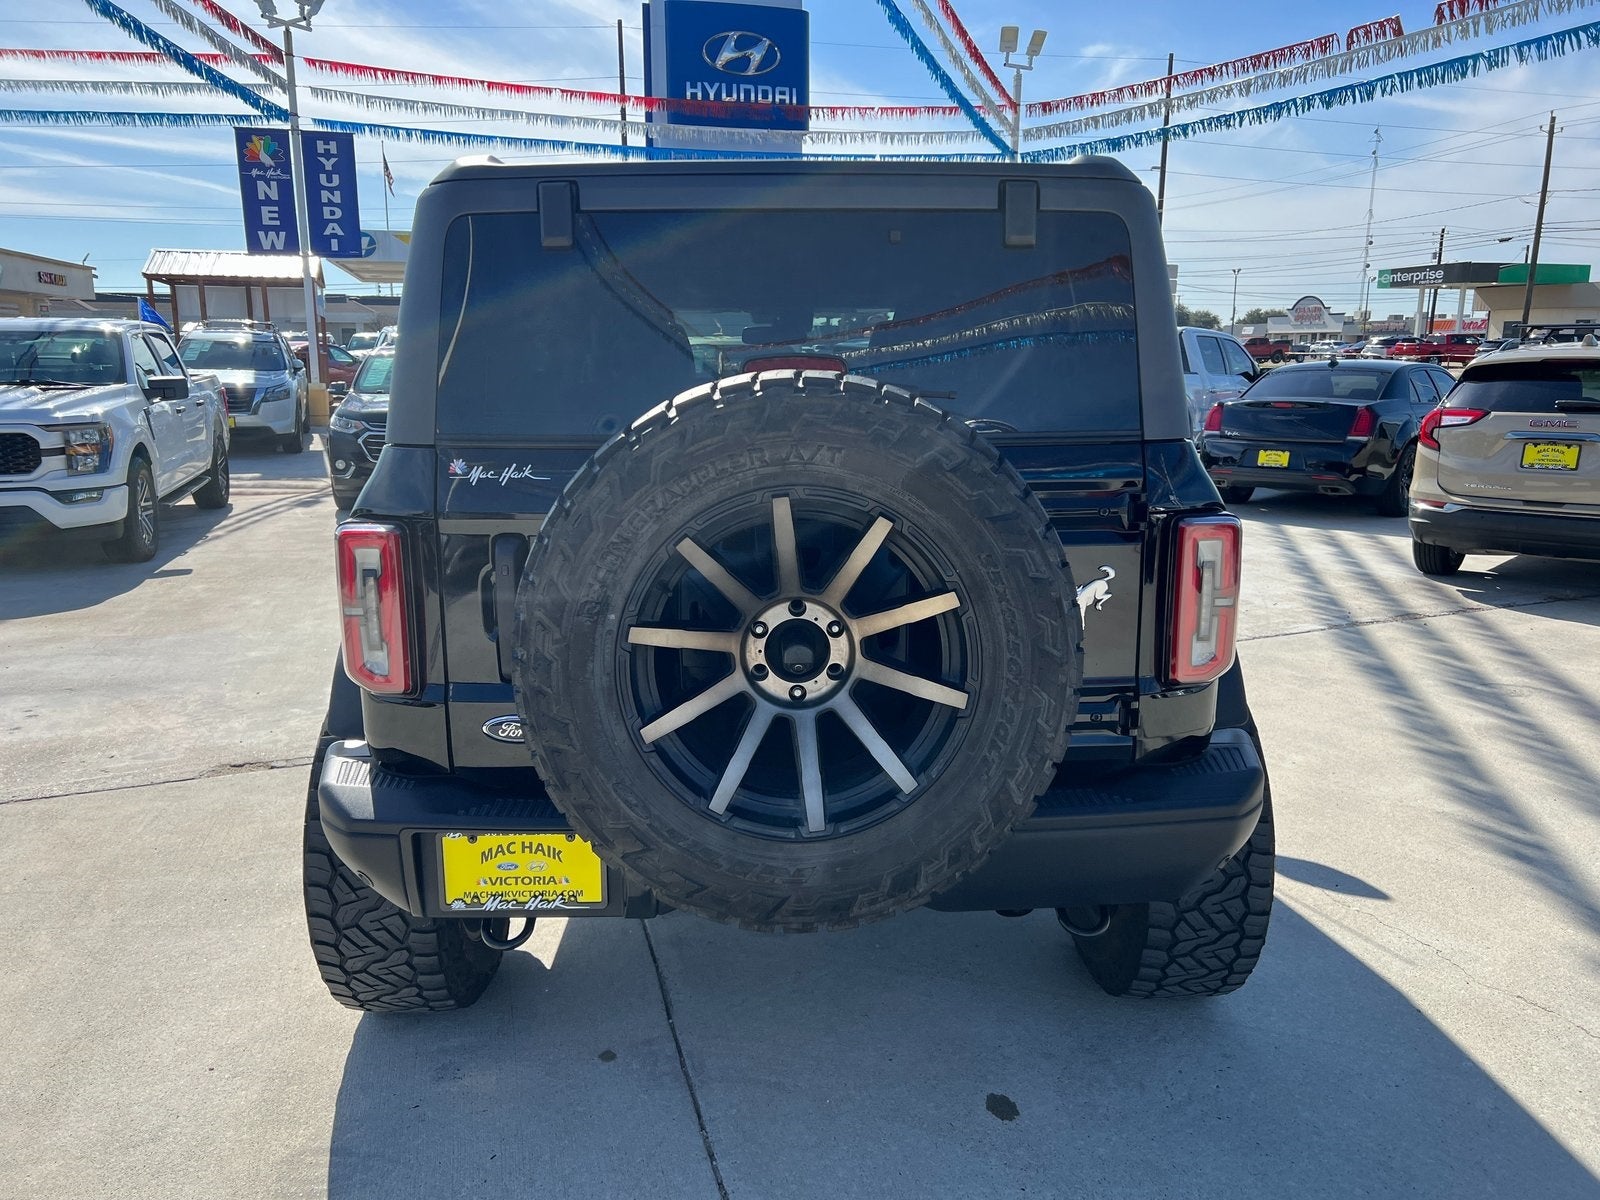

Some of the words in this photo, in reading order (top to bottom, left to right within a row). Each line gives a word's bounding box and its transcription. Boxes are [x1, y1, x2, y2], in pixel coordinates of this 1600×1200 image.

[685, 81, 797, 105] HYUNDAI
[316, 140, 345, 251] HYUNDAI
[256, 180, 286, 250] NEW
[1380, 268, 1444, 284] enterprise
[1528, 418, 1580, 428] GMC
[467, 465, 499, 486] Mac
[499, 463, 536, 486] Haik
[498, 721, 523, 738] For
[480, 841, 516, 864] MAC
[521, 841, 563, 863] HAIK
[487, 876, 558, 886] VICTORIA
[463, 889, 584, 899] MACHAIKVICTORIA.COM
[482, 896, 524, 911] Mac
[524, 895, 569, 911] Haik
